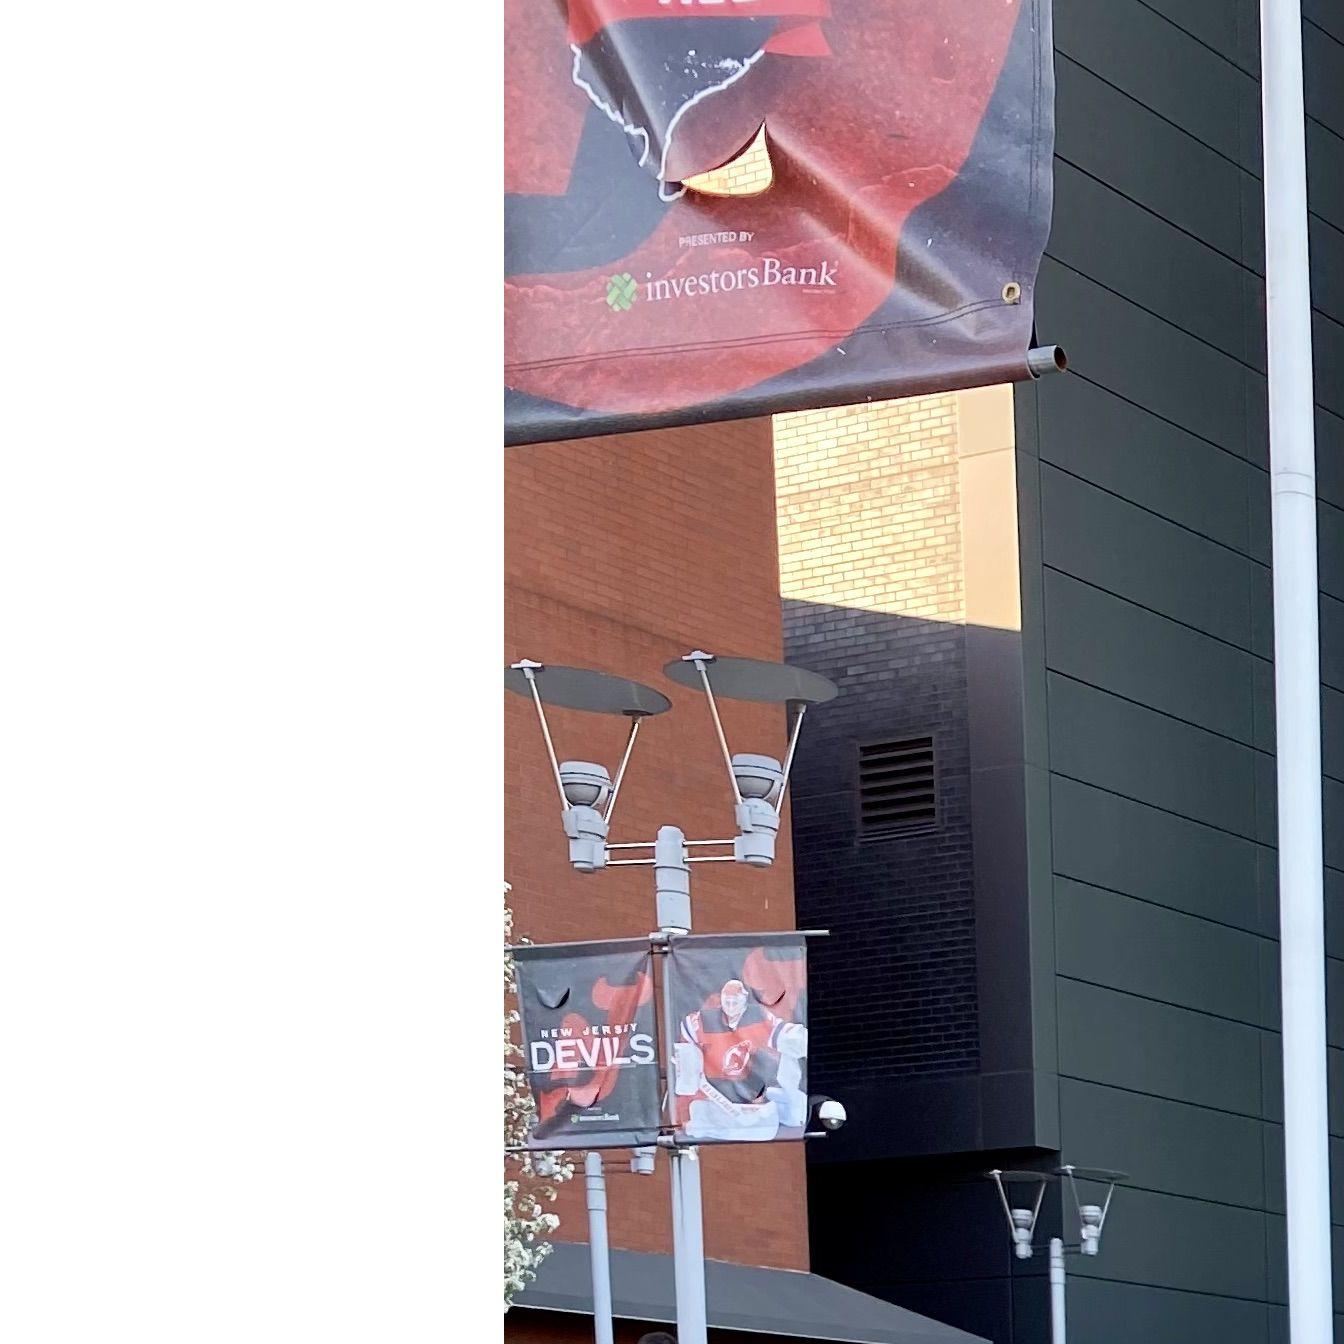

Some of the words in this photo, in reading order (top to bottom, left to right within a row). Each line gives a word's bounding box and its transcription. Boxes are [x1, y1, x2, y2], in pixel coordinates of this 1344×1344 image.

[679, 231, 737, 248] PRESENTED
[738, 231, 756, 243] BY
[540, 1027, 572, 1038] NEW
[530, 1033, 656, 1071] DEVILS
